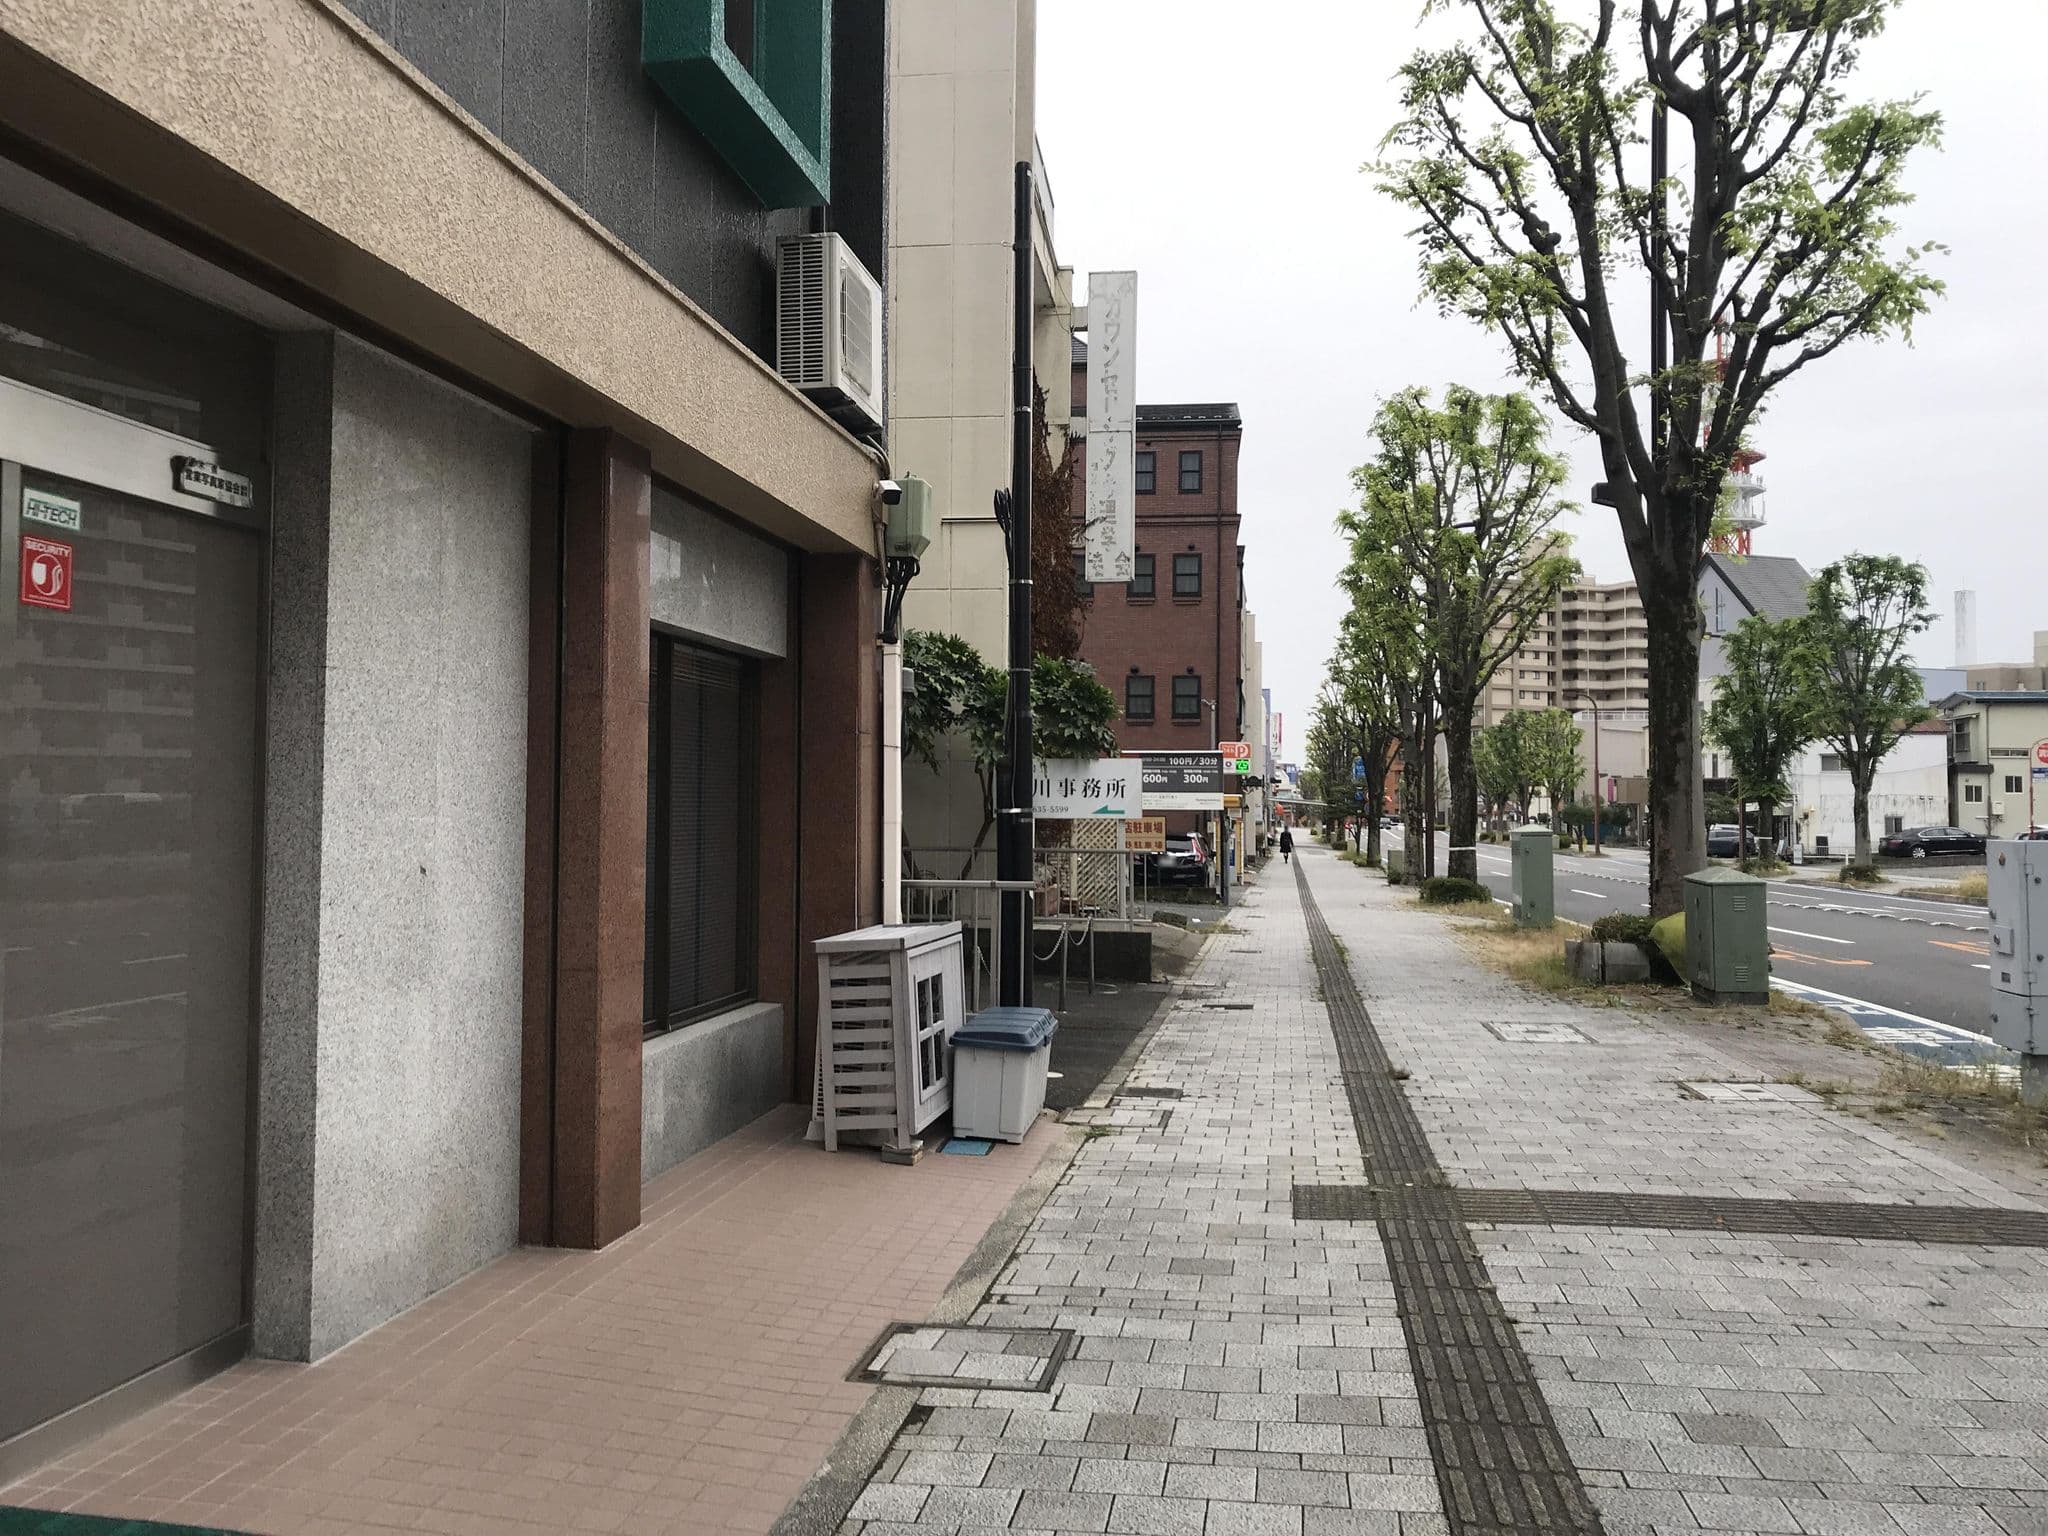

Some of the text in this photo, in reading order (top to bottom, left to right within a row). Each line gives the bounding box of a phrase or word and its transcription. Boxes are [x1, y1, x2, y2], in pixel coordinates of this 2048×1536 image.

[26, 501, 77, 527] HI-TECH
[25, 540, 71, 557] SECURITY
[1142, 774, 1168, 783] 600円
[1183, 774, 1209, 783] 300円
